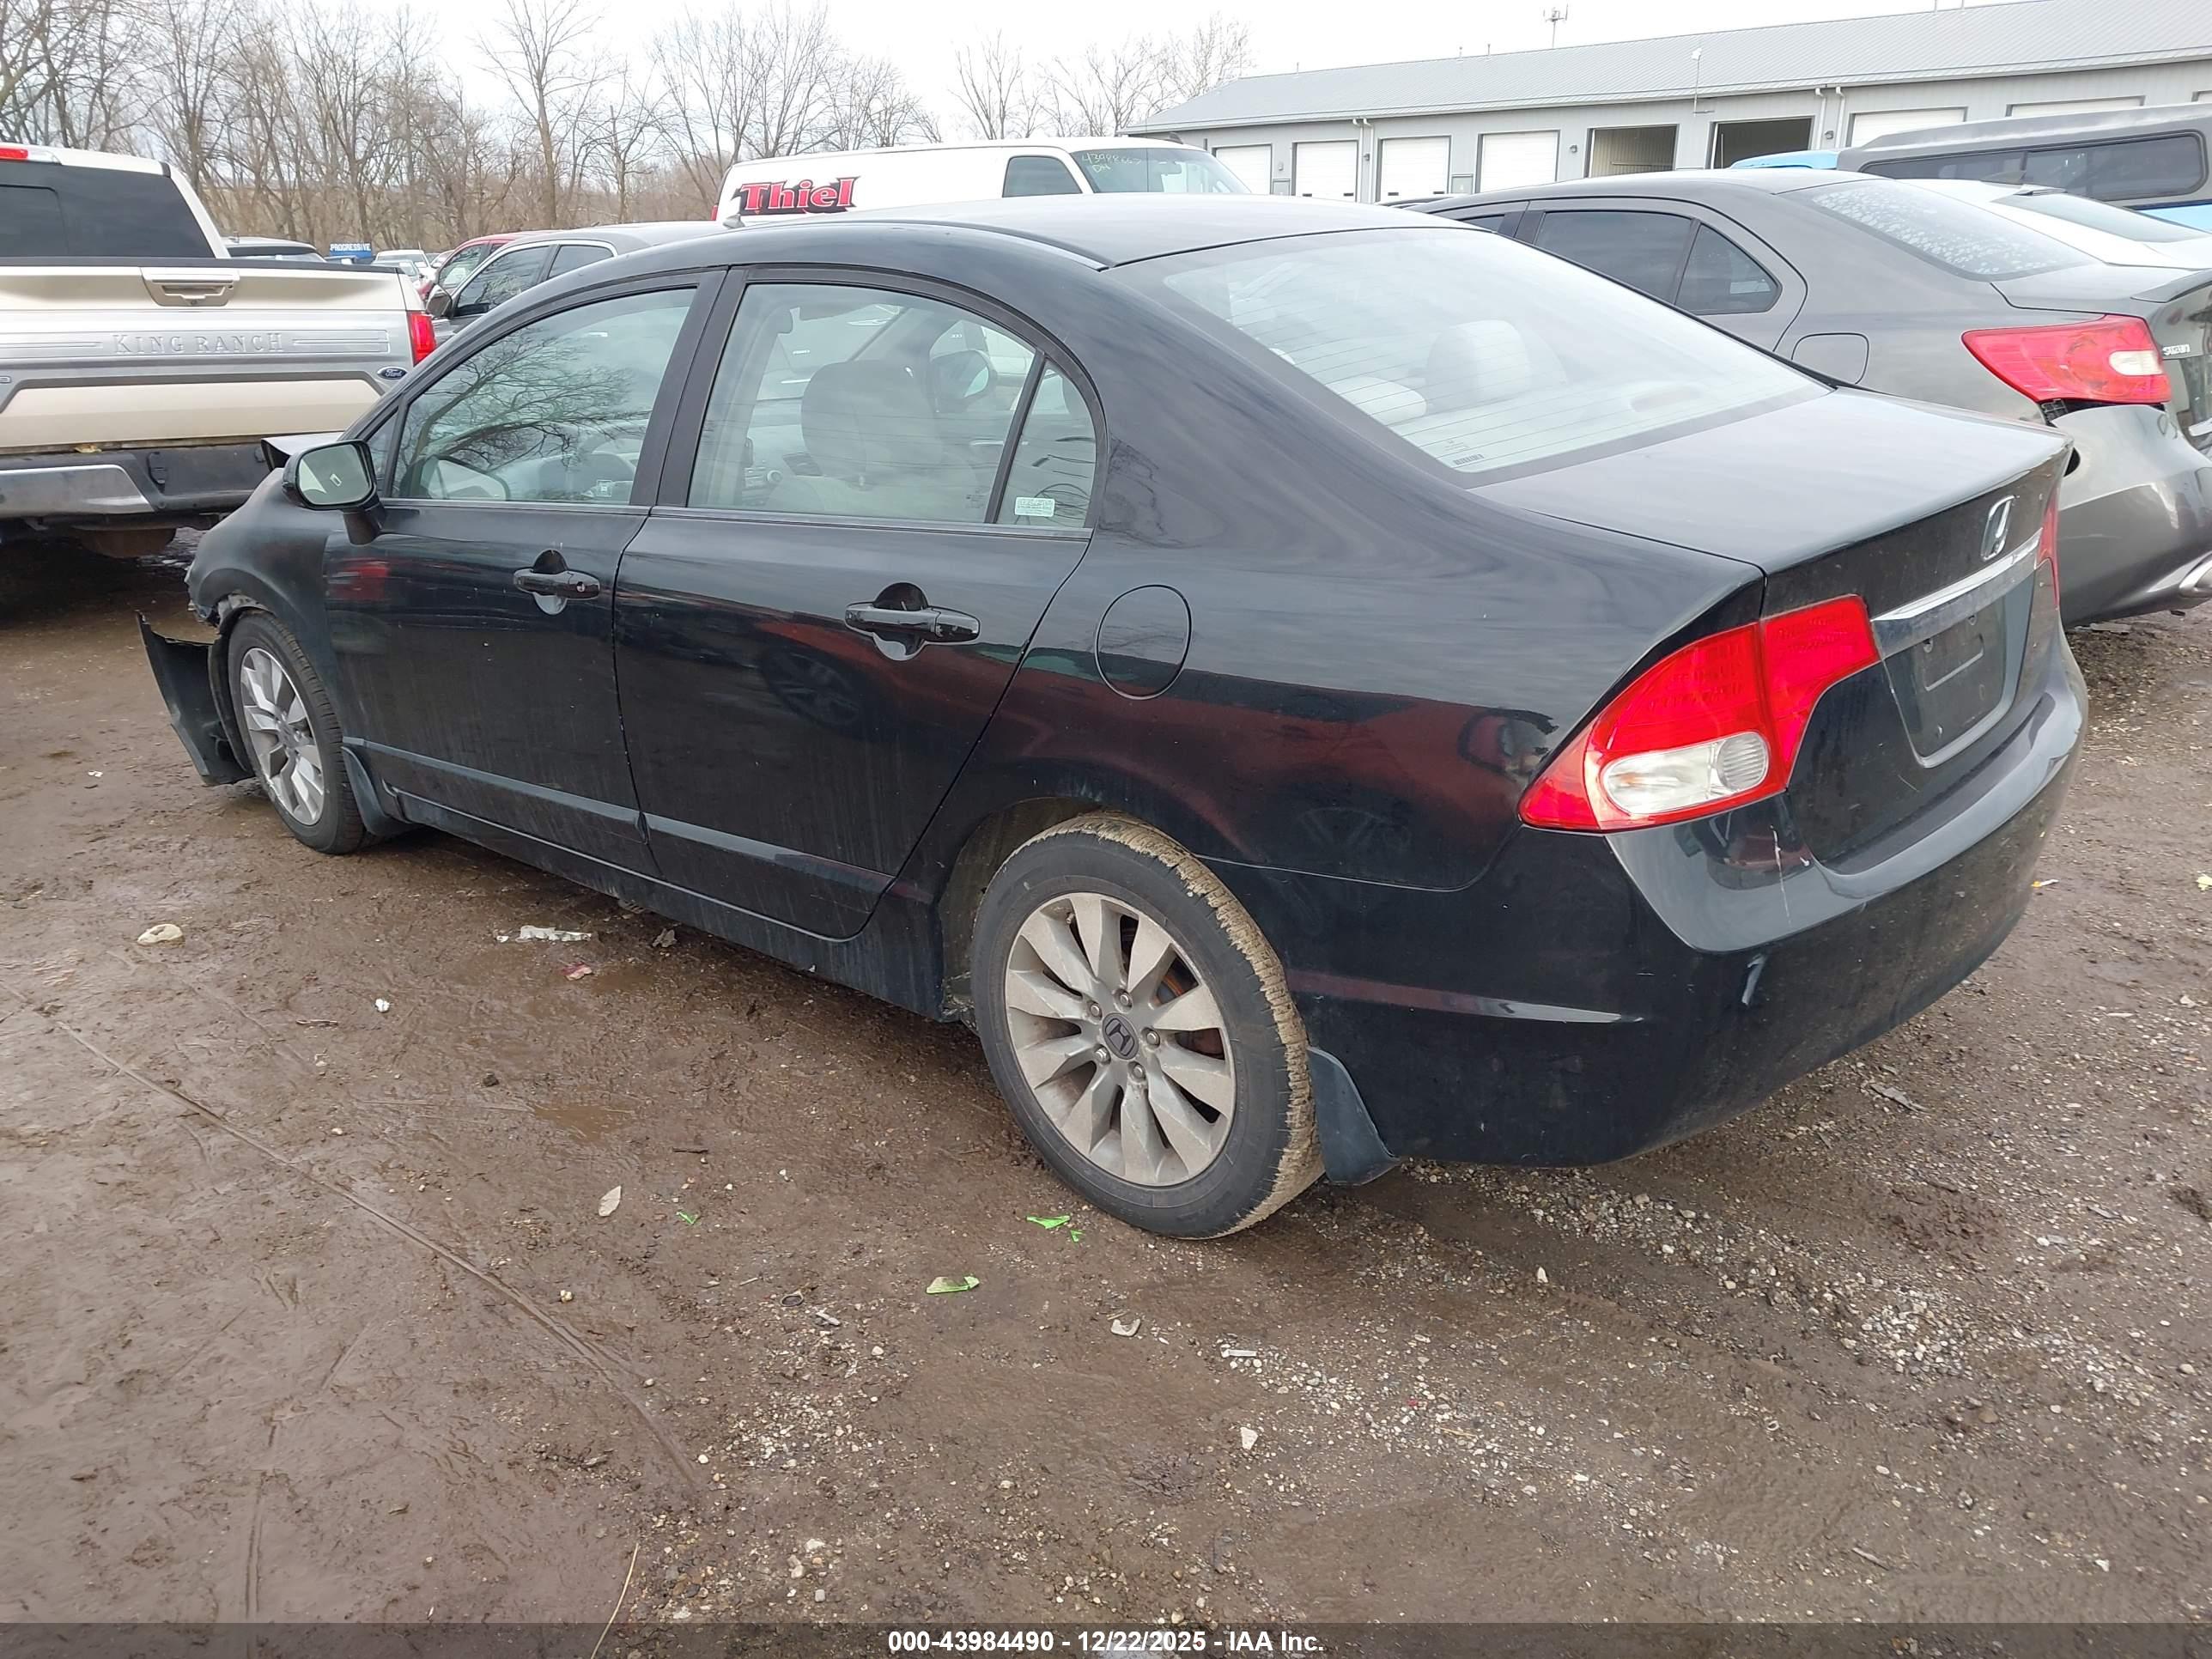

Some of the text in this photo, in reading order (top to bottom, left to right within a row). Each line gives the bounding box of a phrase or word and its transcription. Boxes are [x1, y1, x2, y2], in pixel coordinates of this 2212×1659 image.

[738, 178, 859, 212] Thiel
[330, 243, 372, 252] PROGRESSIVE
[112, 332, 285, 354] KING RANCH
